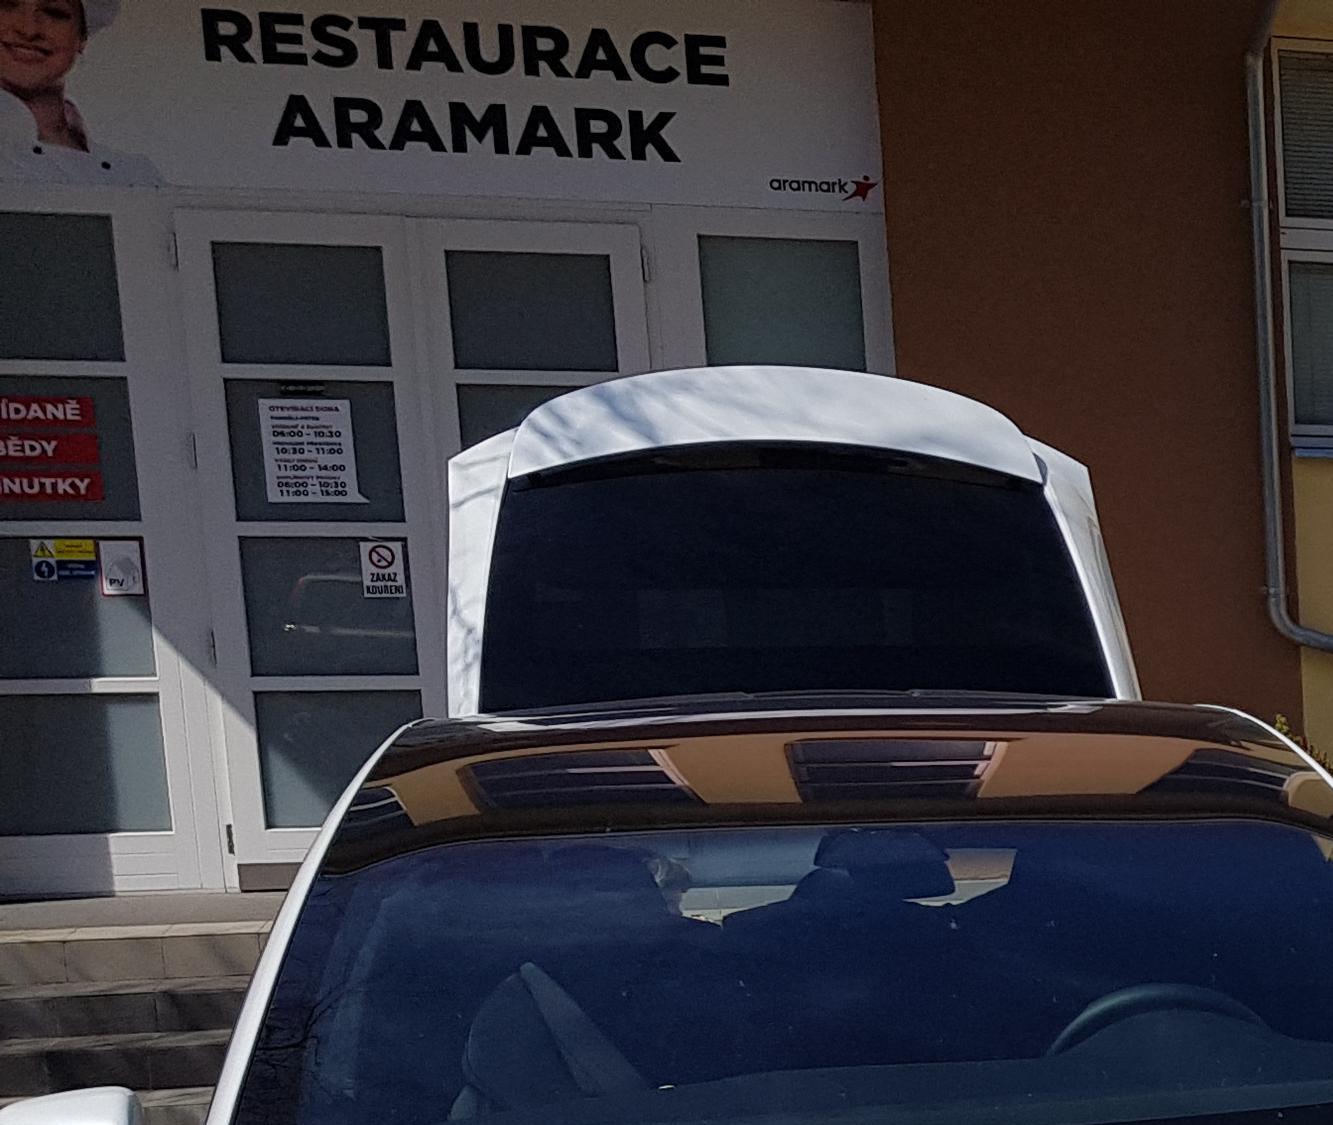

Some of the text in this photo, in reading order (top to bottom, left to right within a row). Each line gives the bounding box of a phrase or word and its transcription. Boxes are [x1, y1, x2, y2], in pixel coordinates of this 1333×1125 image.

[201, 8, 730, 87] RESTAURACE
[272, 94, 682, 163] ARAMARK
[769, 178, 848, 194] aramark
[315, 447, 343, 455] 11:00
[277, 464, 307, 472] 11:00
